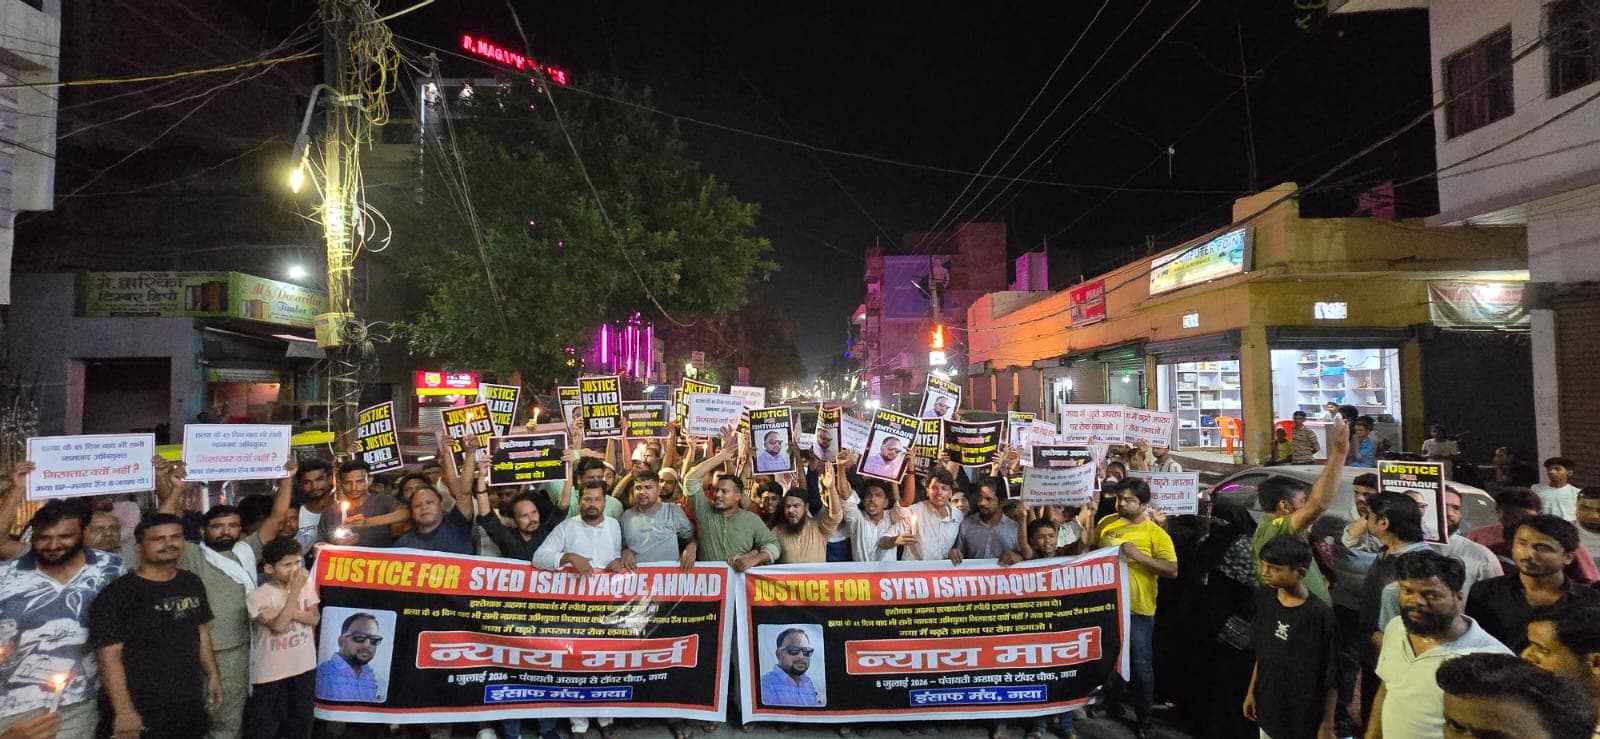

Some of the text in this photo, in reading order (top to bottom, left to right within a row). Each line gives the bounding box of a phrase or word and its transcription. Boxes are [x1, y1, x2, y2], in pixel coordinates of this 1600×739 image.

[582, 380, 616, 392] JUSTICE
[583, 392, 617, 404] DELAYED
[359, 405, 390, 426] JUSTICE
[583, 406, 590, 417] IS
[592, 404, 619, 416] JUSTICE
[751, 409, 788, 419] JUSTICE
[358, 418, 391, 438] DELAYED
[590, 417, 615, 429] DENIED
[877, 412, 918, 429] JUSTICE
[366, 432, 395, 450] JUSTICE
[363, 447, 392, 464] DENIED
[1382, 464, 1439, 476] JUSTICE
[1382, 480, 1438, 488] ISHTIYAQUE
[325, 556, 721, 598] JUSTICE FOR SYED ISHTIYAQUE AHMAD
[753, 562, 1115, 602] JUSTICE FOR SYED ISHTIYAQUE AHMAD
[430, 638, 690, 668] न्याय मार्च
[856, 631, 1092, 668] न्याय मार्च
[448, 674, 454, 683] 8
[456, 670, 487, 685] जुलाई
[519, 672, 553, 683] पंचायती
[590, 675, 598, 684] से
[876, 680, 881, 688] 8
[882, 677, 909, 690] जुलाई
[938, 675, 970, 685] पंचायती
[1004, 672, 1013, 682] से
[491, 686, 627, 701] इंसाफ मंच, गया
[914, 689, 1042, 704] इंसाफ मंच, गया
